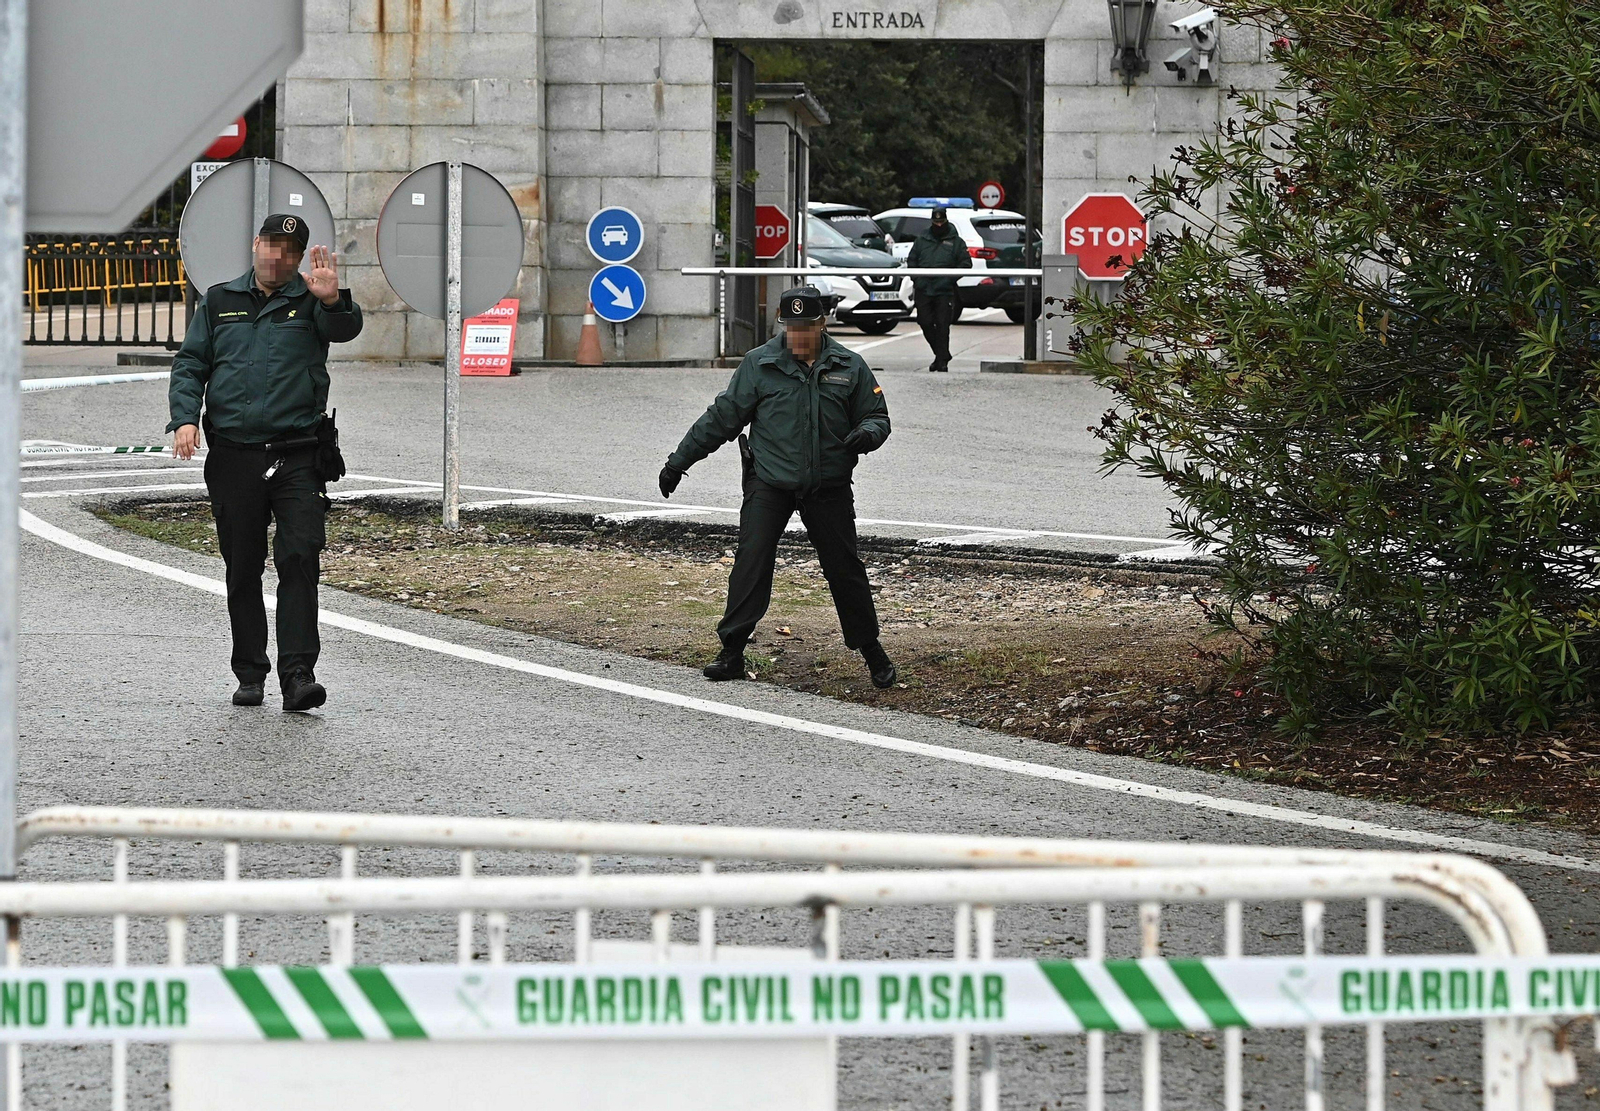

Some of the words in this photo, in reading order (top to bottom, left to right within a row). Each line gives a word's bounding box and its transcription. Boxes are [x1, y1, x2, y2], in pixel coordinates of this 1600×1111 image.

[832, 12, 925, 28] ENTRADA
[196, 164, 224, 172] EXCE
[755, 225, 787, 238] TOP
[1068, 226, 1144, 247] STOP
[481, 307, 515, 315] RADO
[463, 357, 508, 366] CLOSED
[1341, 968, 1509, 1013] GUARDIA
[1529, 968, 1600, 1007] CIVI
[1, 980, 47, 1027] NO
[65, 980, 187, 1027] PASAR
[516, 976, 684, 1024] GUARDIA
[701, 975, 794, 1023] CIVIL
[812, 974, 861, 1021] NO
[879, 974, 1005, 1021] PASAR
